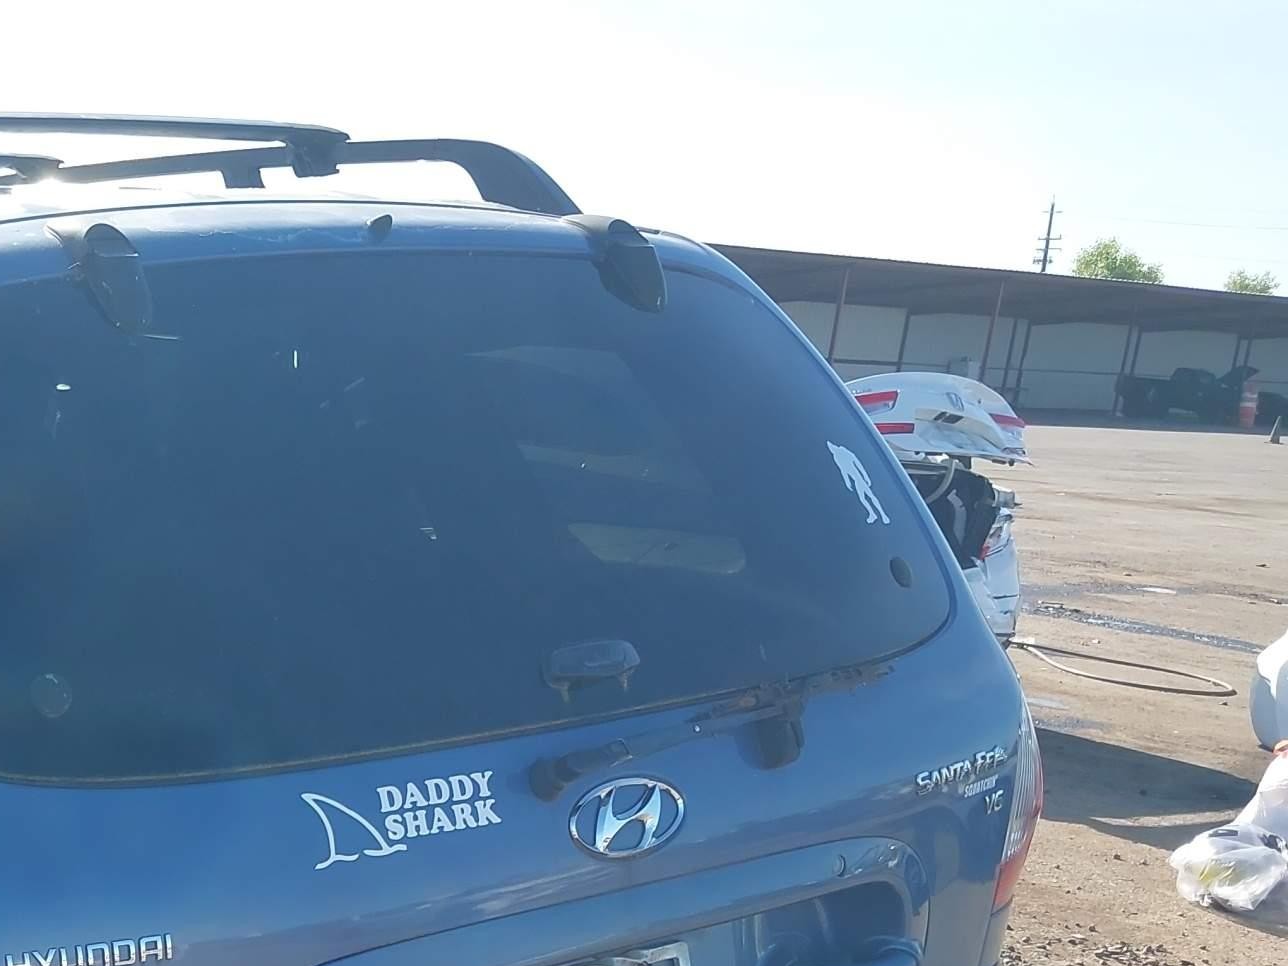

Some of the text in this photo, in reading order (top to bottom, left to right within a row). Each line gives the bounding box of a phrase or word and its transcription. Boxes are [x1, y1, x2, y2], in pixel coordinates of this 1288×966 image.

[376, 770, 493, 813] DADDY
[915, 759, 973, 795] SANTA
[384, 798, 502, 841] SHARK
[984, 789, 1004, 815] V6
